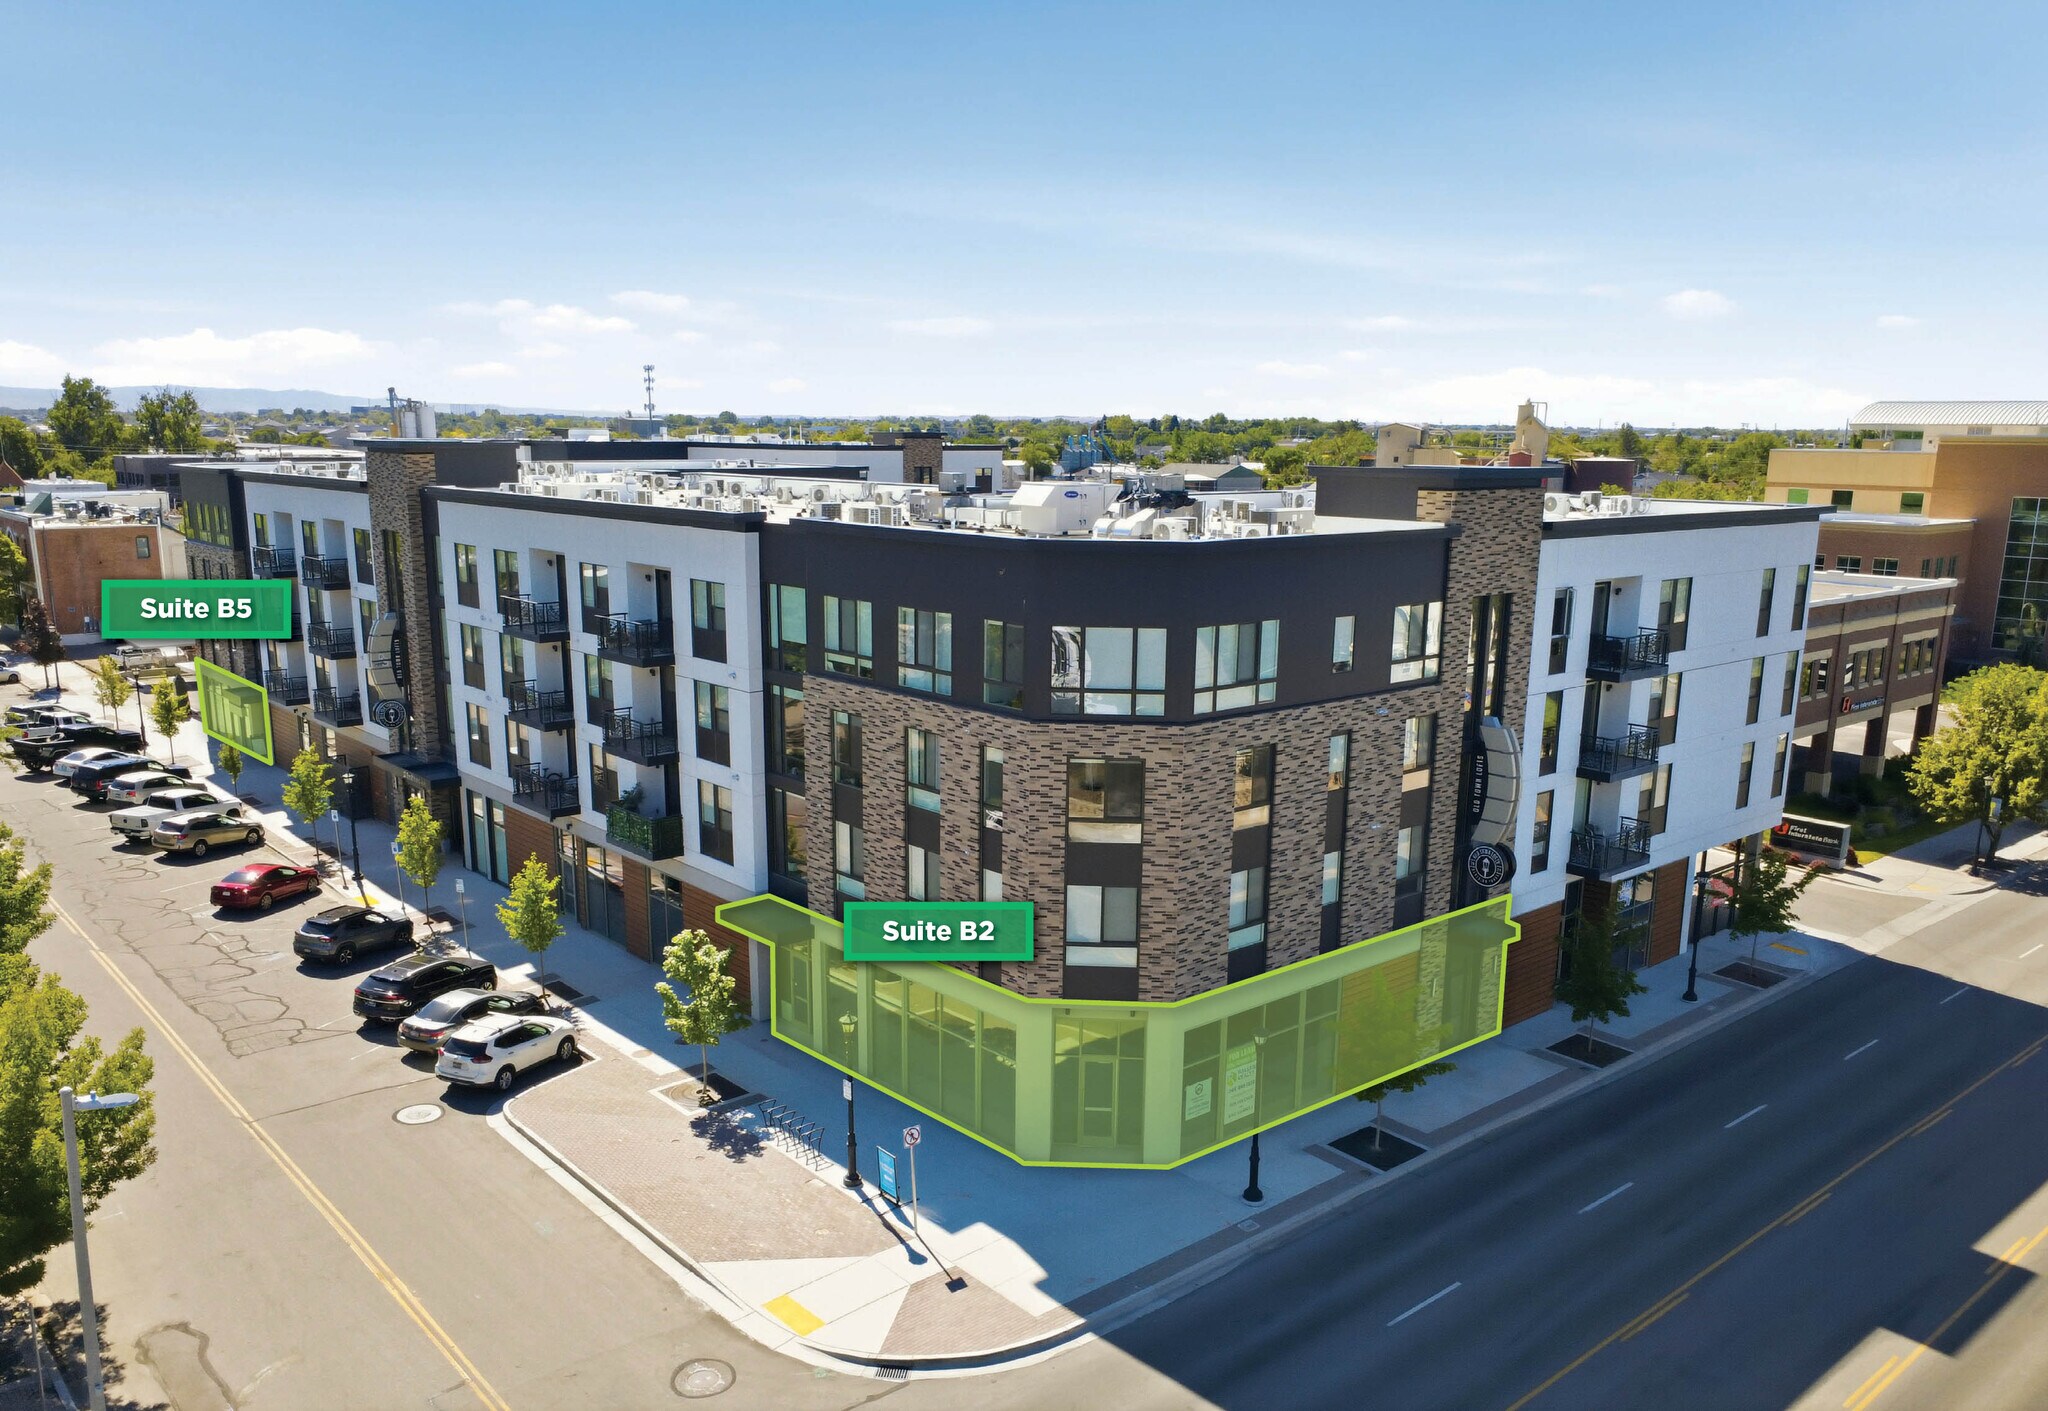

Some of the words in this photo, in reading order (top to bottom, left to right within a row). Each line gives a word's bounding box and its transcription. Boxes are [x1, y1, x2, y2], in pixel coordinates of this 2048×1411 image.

[1475, 755, 1484, 776] LOFTS
[1473, 778, 1482, 797] TOWN
[1472, 799, 1481, 813] OLD
[1790, 825, 1807, 833] First
[1788, 831, 1823, 842] Interstate
